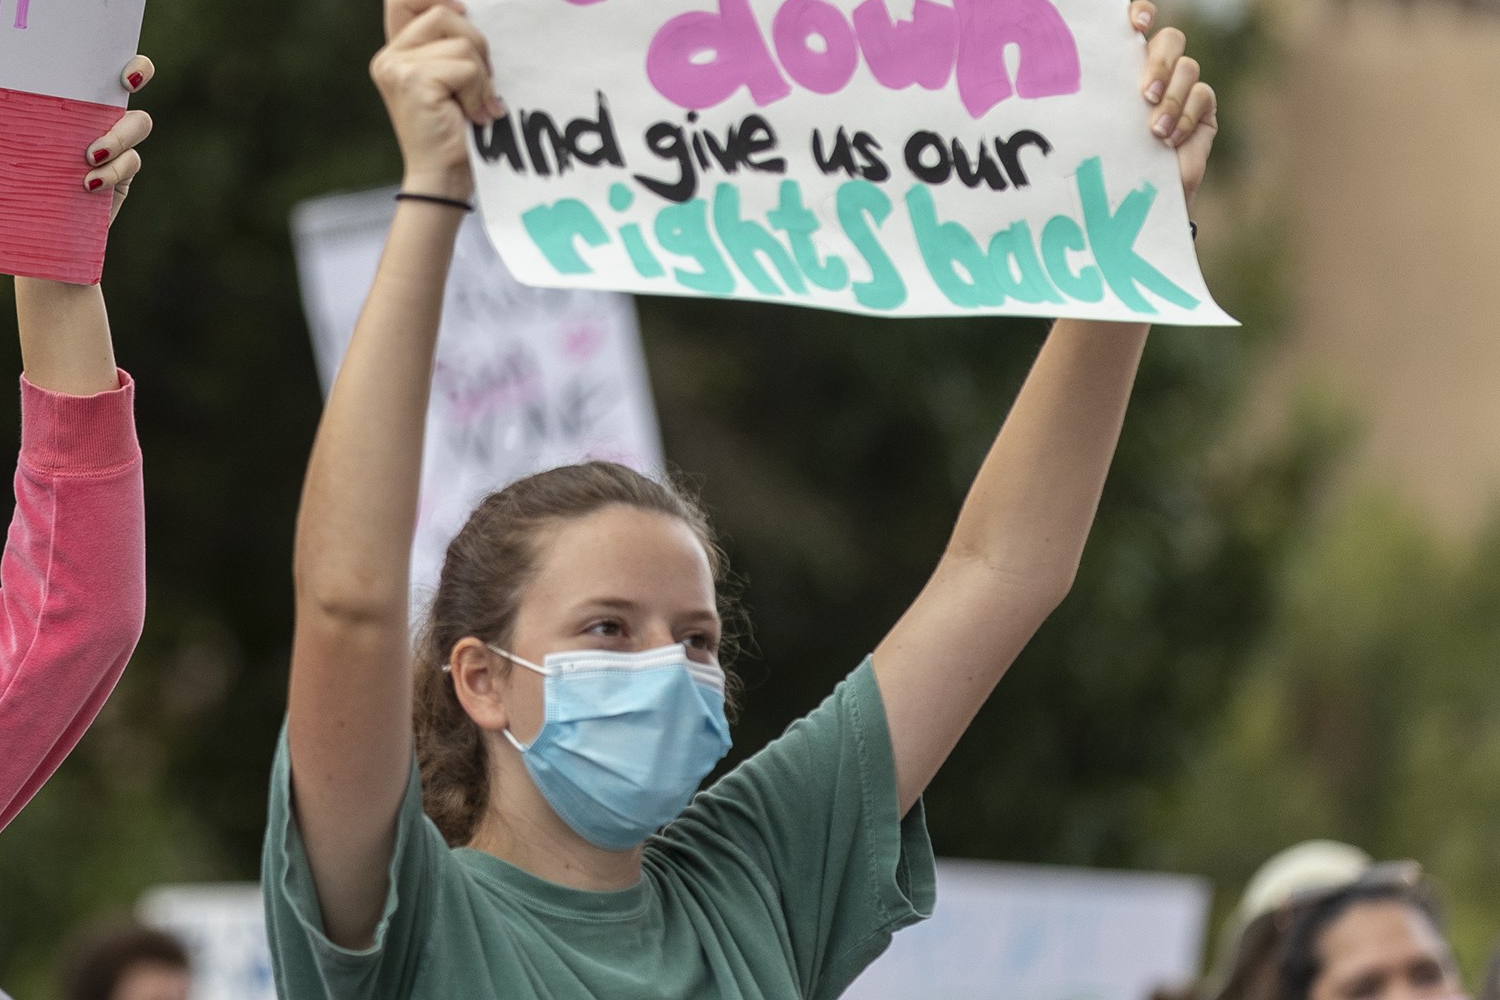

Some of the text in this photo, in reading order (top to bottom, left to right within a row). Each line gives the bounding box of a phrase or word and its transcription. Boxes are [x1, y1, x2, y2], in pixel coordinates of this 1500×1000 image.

[473, 90, 1050, 203] and give us our
[521, 156, 1200, 313] rights back
